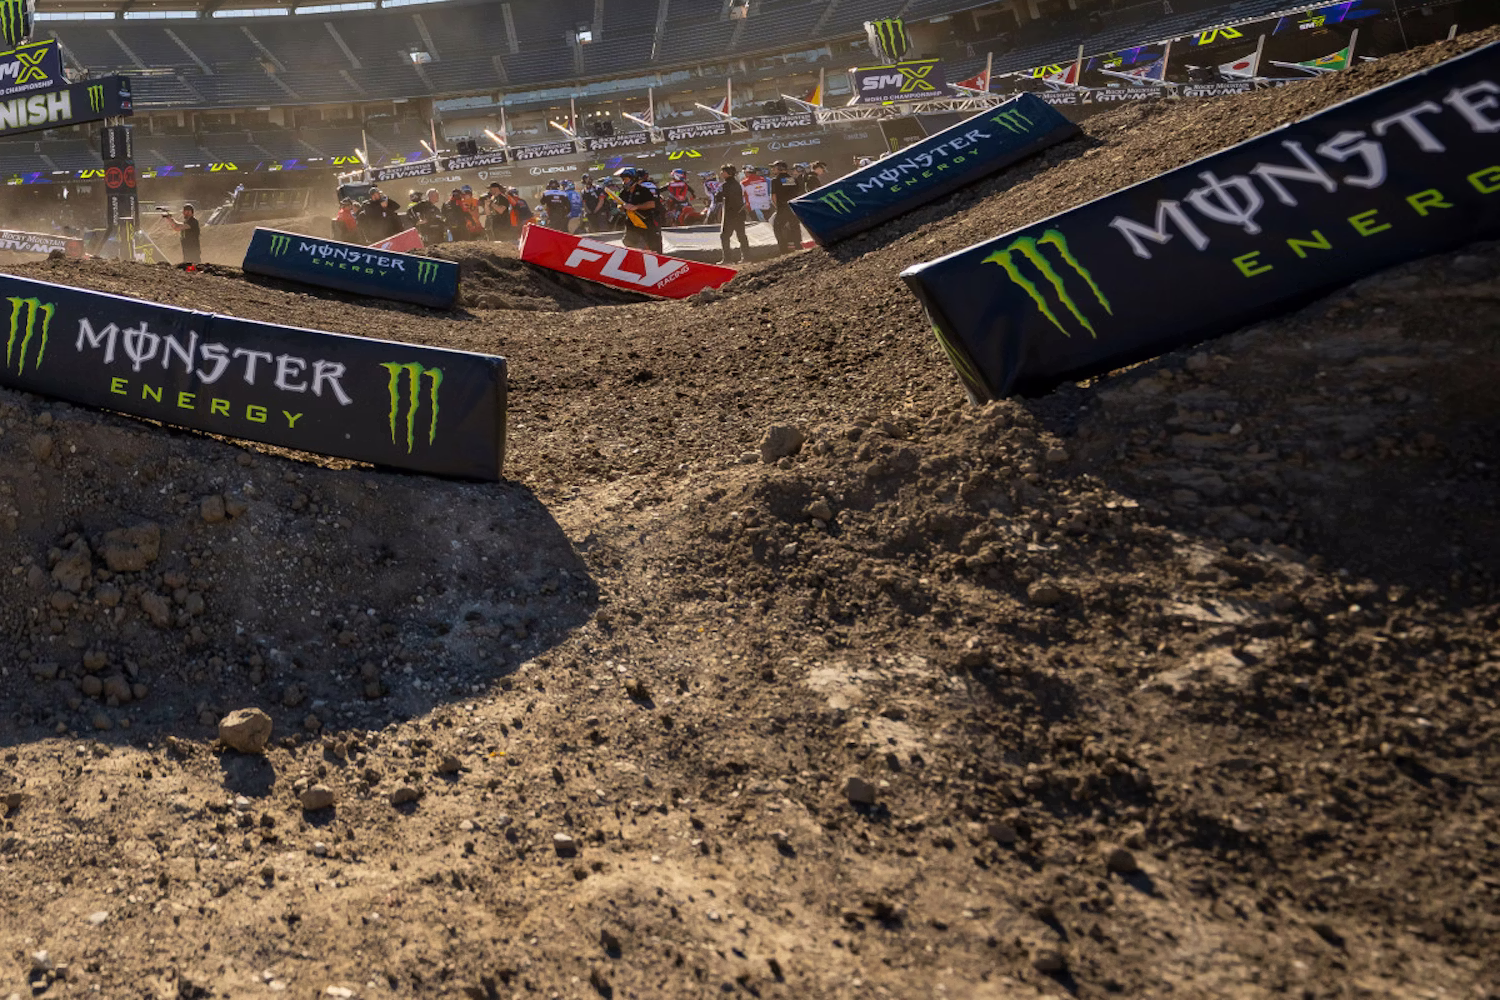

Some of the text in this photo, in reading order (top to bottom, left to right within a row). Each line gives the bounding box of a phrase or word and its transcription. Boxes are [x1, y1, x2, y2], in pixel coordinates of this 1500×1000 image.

[5, 79, 53, 95] CHAMPIONSHIP
[862, 66, 936, 93] SMX
[890, 90, 942, 101] CHAMPIONSHIP
[782, 138, 821, 148] LEXUS
[541, 165, 577, 173] LEXUS
[856, 127, 992, 194] MONSTER
[889, 147, 980, 194] ENERGY
[1, 231, 66, 247] ROCKY MOUNTAIN
[299, 241, 406, 272] MONSTER
[312, 257, 388, 277] ENERGY
[564, 237, 687, 288] FLY
[657, 264, 690, 290] RACING
[74, 315, 353, 405] MONSTER
[109, 376, 304, 429] ENERGY
